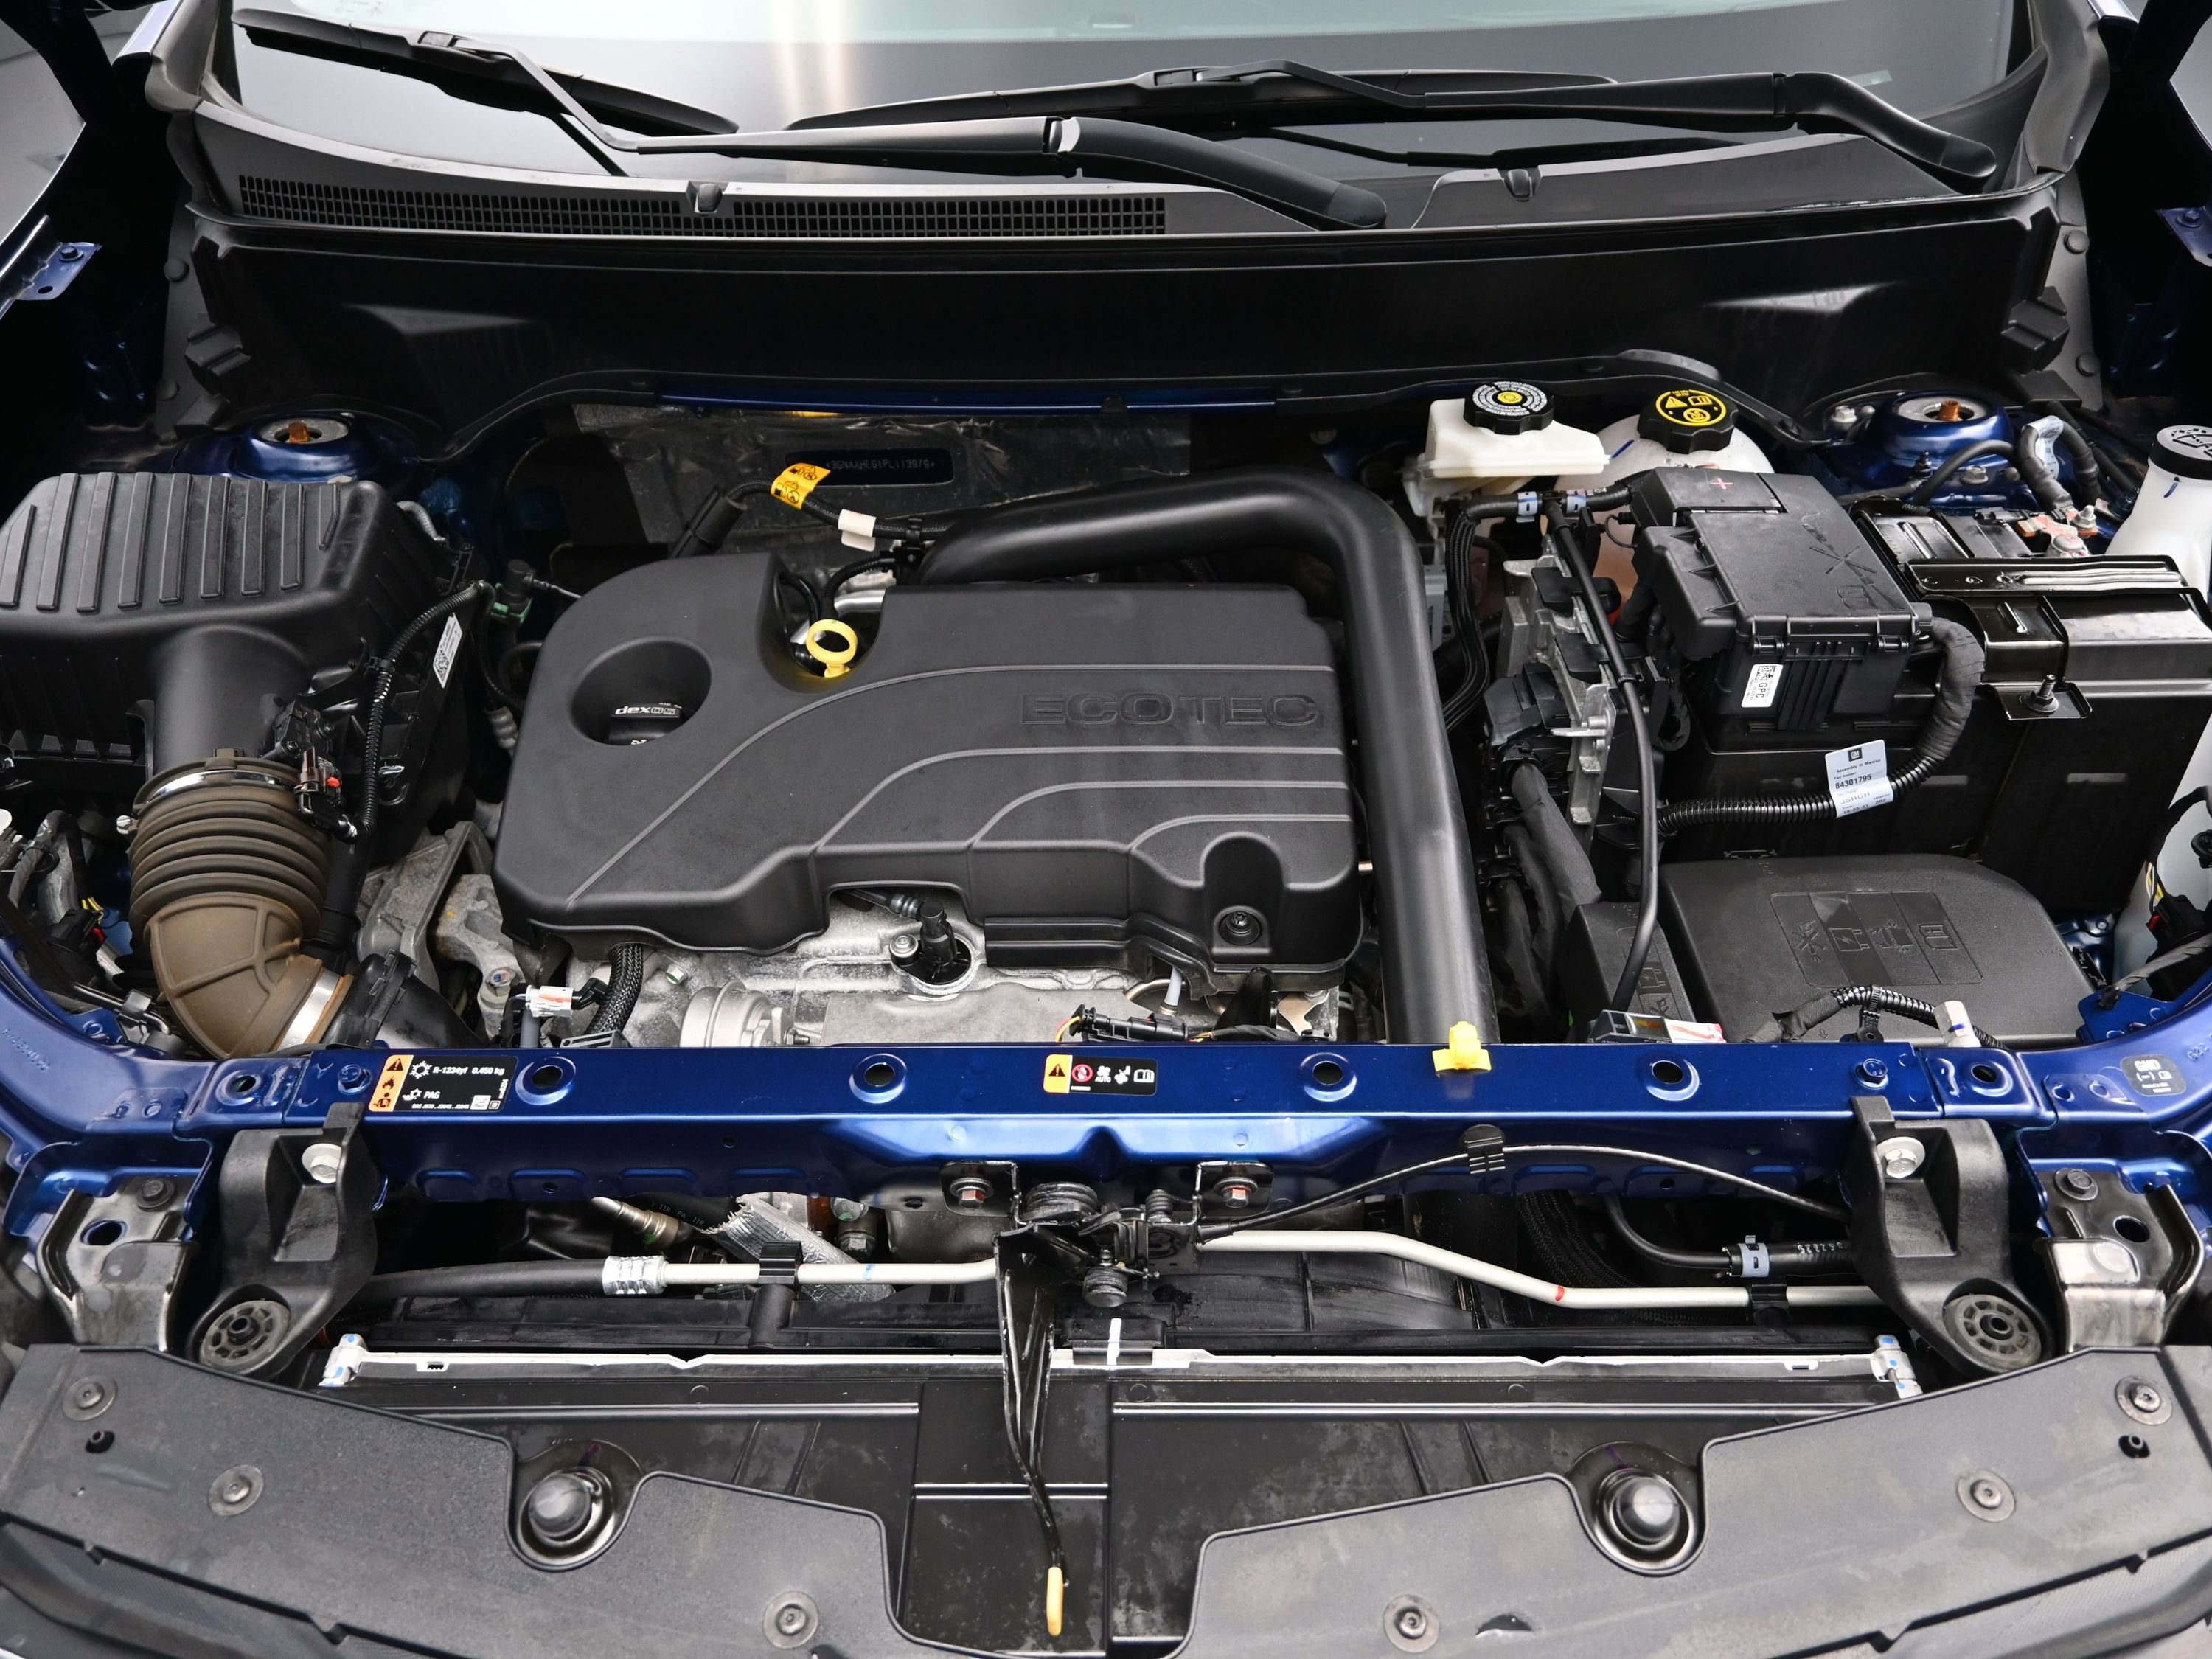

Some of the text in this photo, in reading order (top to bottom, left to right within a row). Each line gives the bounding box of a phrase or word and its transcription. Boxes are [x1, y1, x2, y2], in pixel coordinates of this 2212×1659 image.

[1755, 682, 1768, 698] GPC
[615, 706, 677, 714] dexos
[1021, 693, 1318, 726] ECOTEC
[1835, 774, 1871, 789] 84301795
[471, 1066, 493, 1075] 0.450
[493, 1066, 505, 1076] kg
